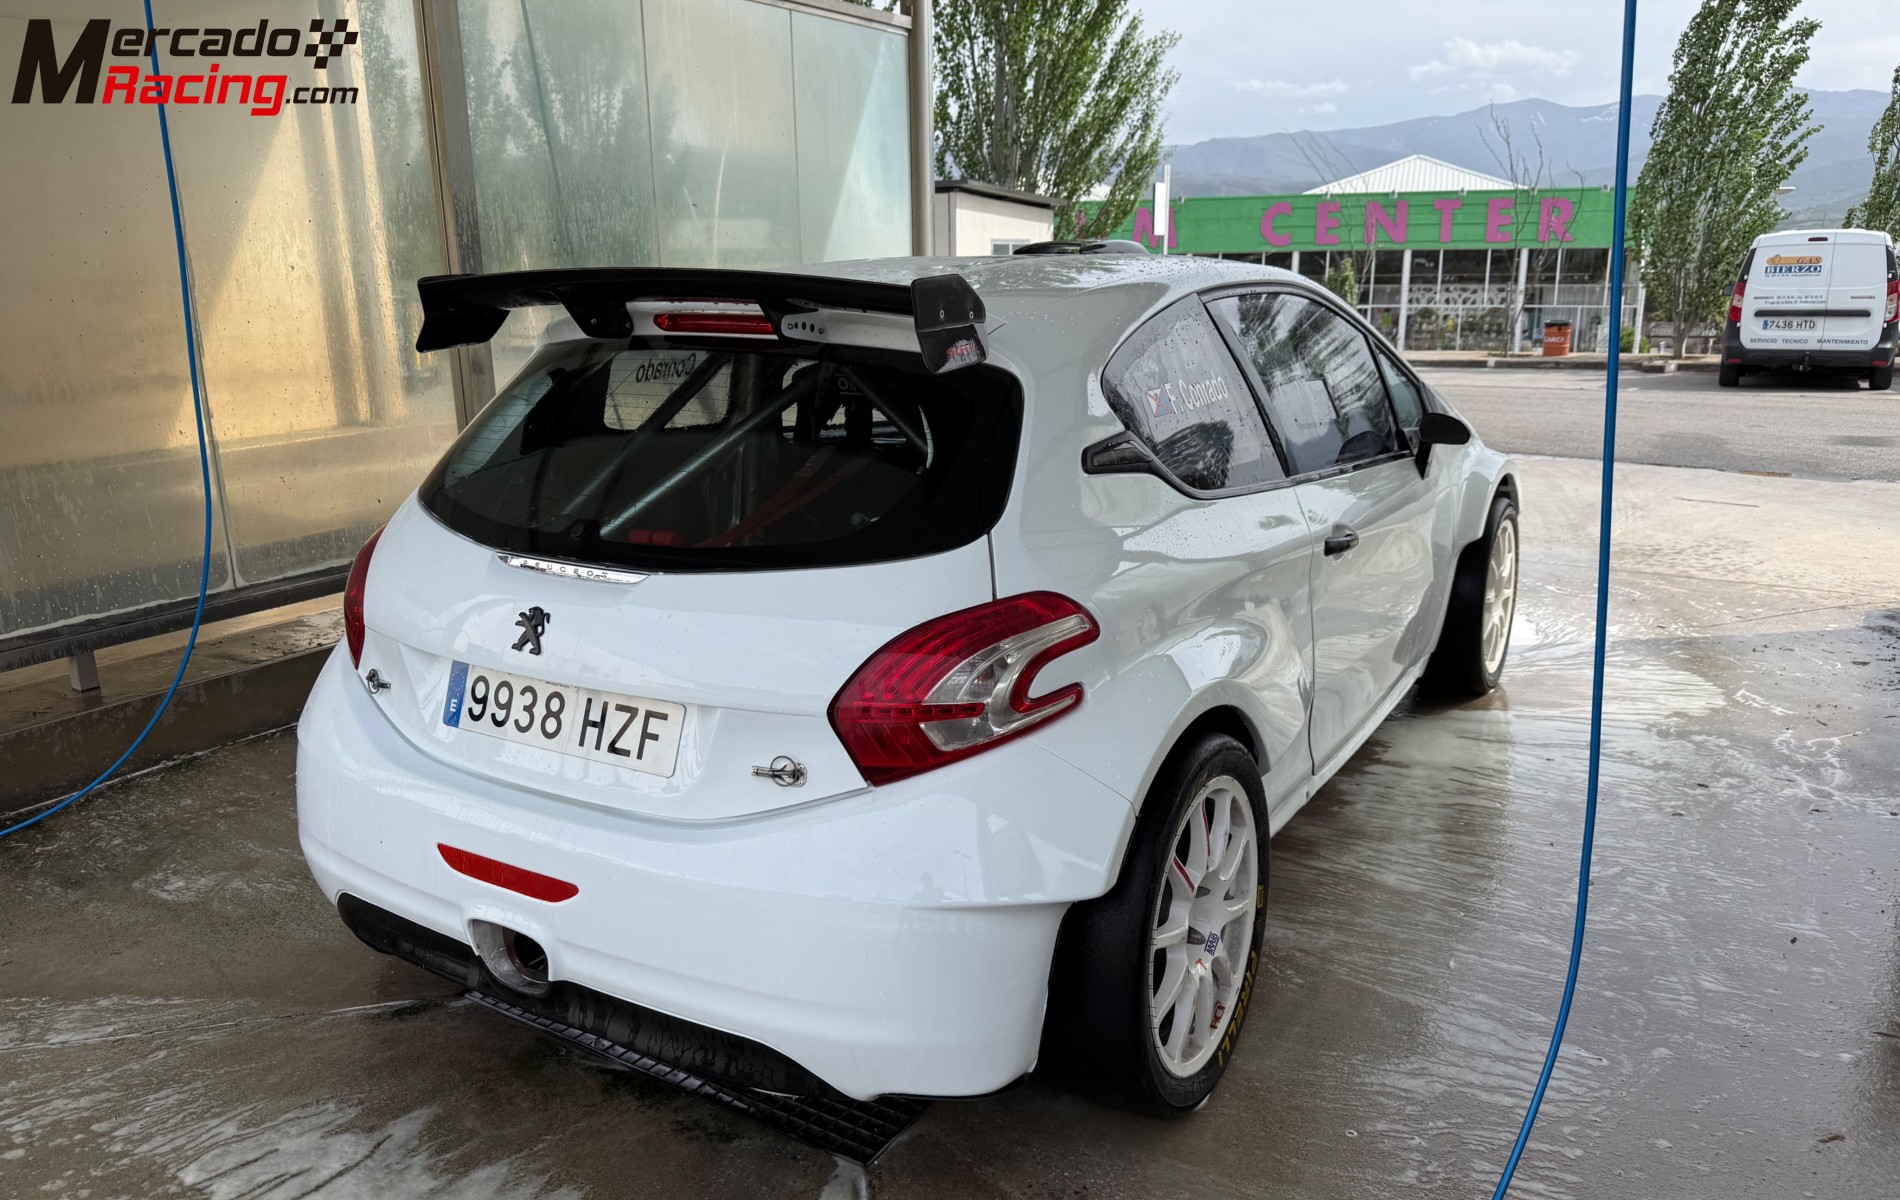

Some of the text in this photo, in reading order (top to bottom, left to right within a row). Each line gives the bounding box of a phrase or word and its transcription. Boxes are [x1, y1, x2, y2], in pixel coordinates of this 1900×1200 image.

[1260, 197, 1575, 247] CENTER
[1766, 265, 1821, 273] BIERZO
[1769, 320, 1816, 329] 7436 HTD
[1179, 370, 1228, 410] Conrado
[522, 560, 608, 579] PEUGEOT
[449, 699, 458, 713] E
[468, 675, 669, 761] 9938 HZF
[1206, 933, 1219, 957] BRAID
[1218, 950, 1257, 1068] PIRELLI
